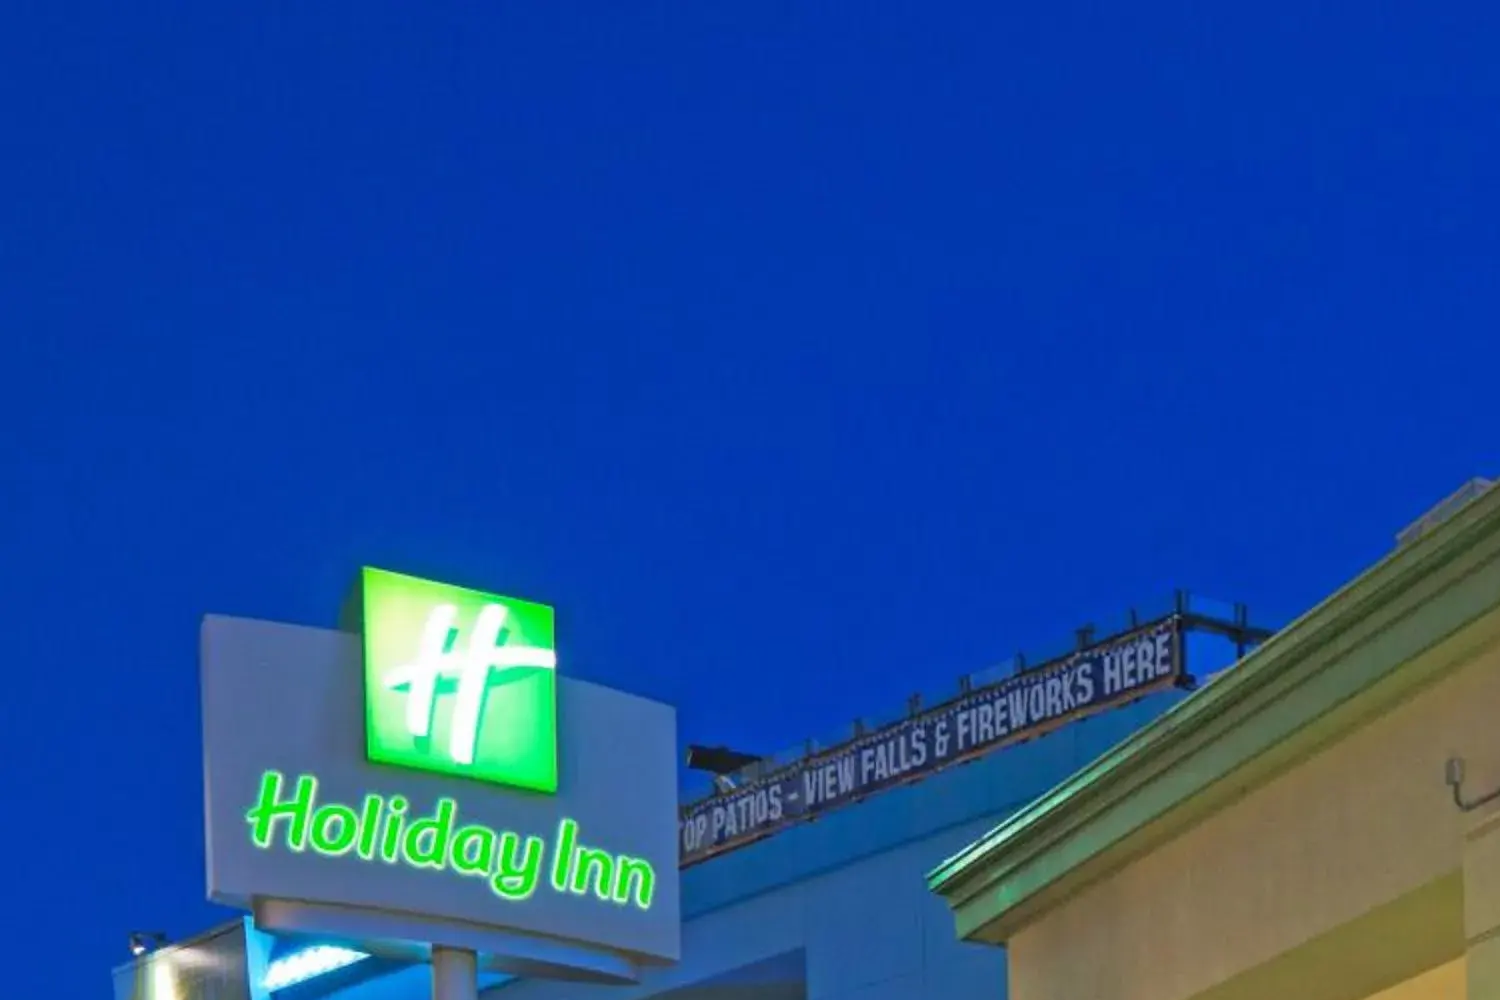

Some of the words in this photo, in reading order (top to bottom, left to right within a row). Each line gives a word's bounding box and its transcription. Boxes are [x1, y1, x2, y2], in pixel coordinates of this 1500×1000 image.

[679, 813, 707, 853] OP
[712, 783, 782, 839] PATIOS
[804, 754, 856, 806] VIEW
[862, 728, 927, 784] FALLS
[934, 721, 951, 758] &
[957, 663, 1094, 750] FIREWORKS
[1103, 632, 1171, 694] HERE
[247, 769, 545, 900] Holiday
[551, 816, 656, 910] Inn
